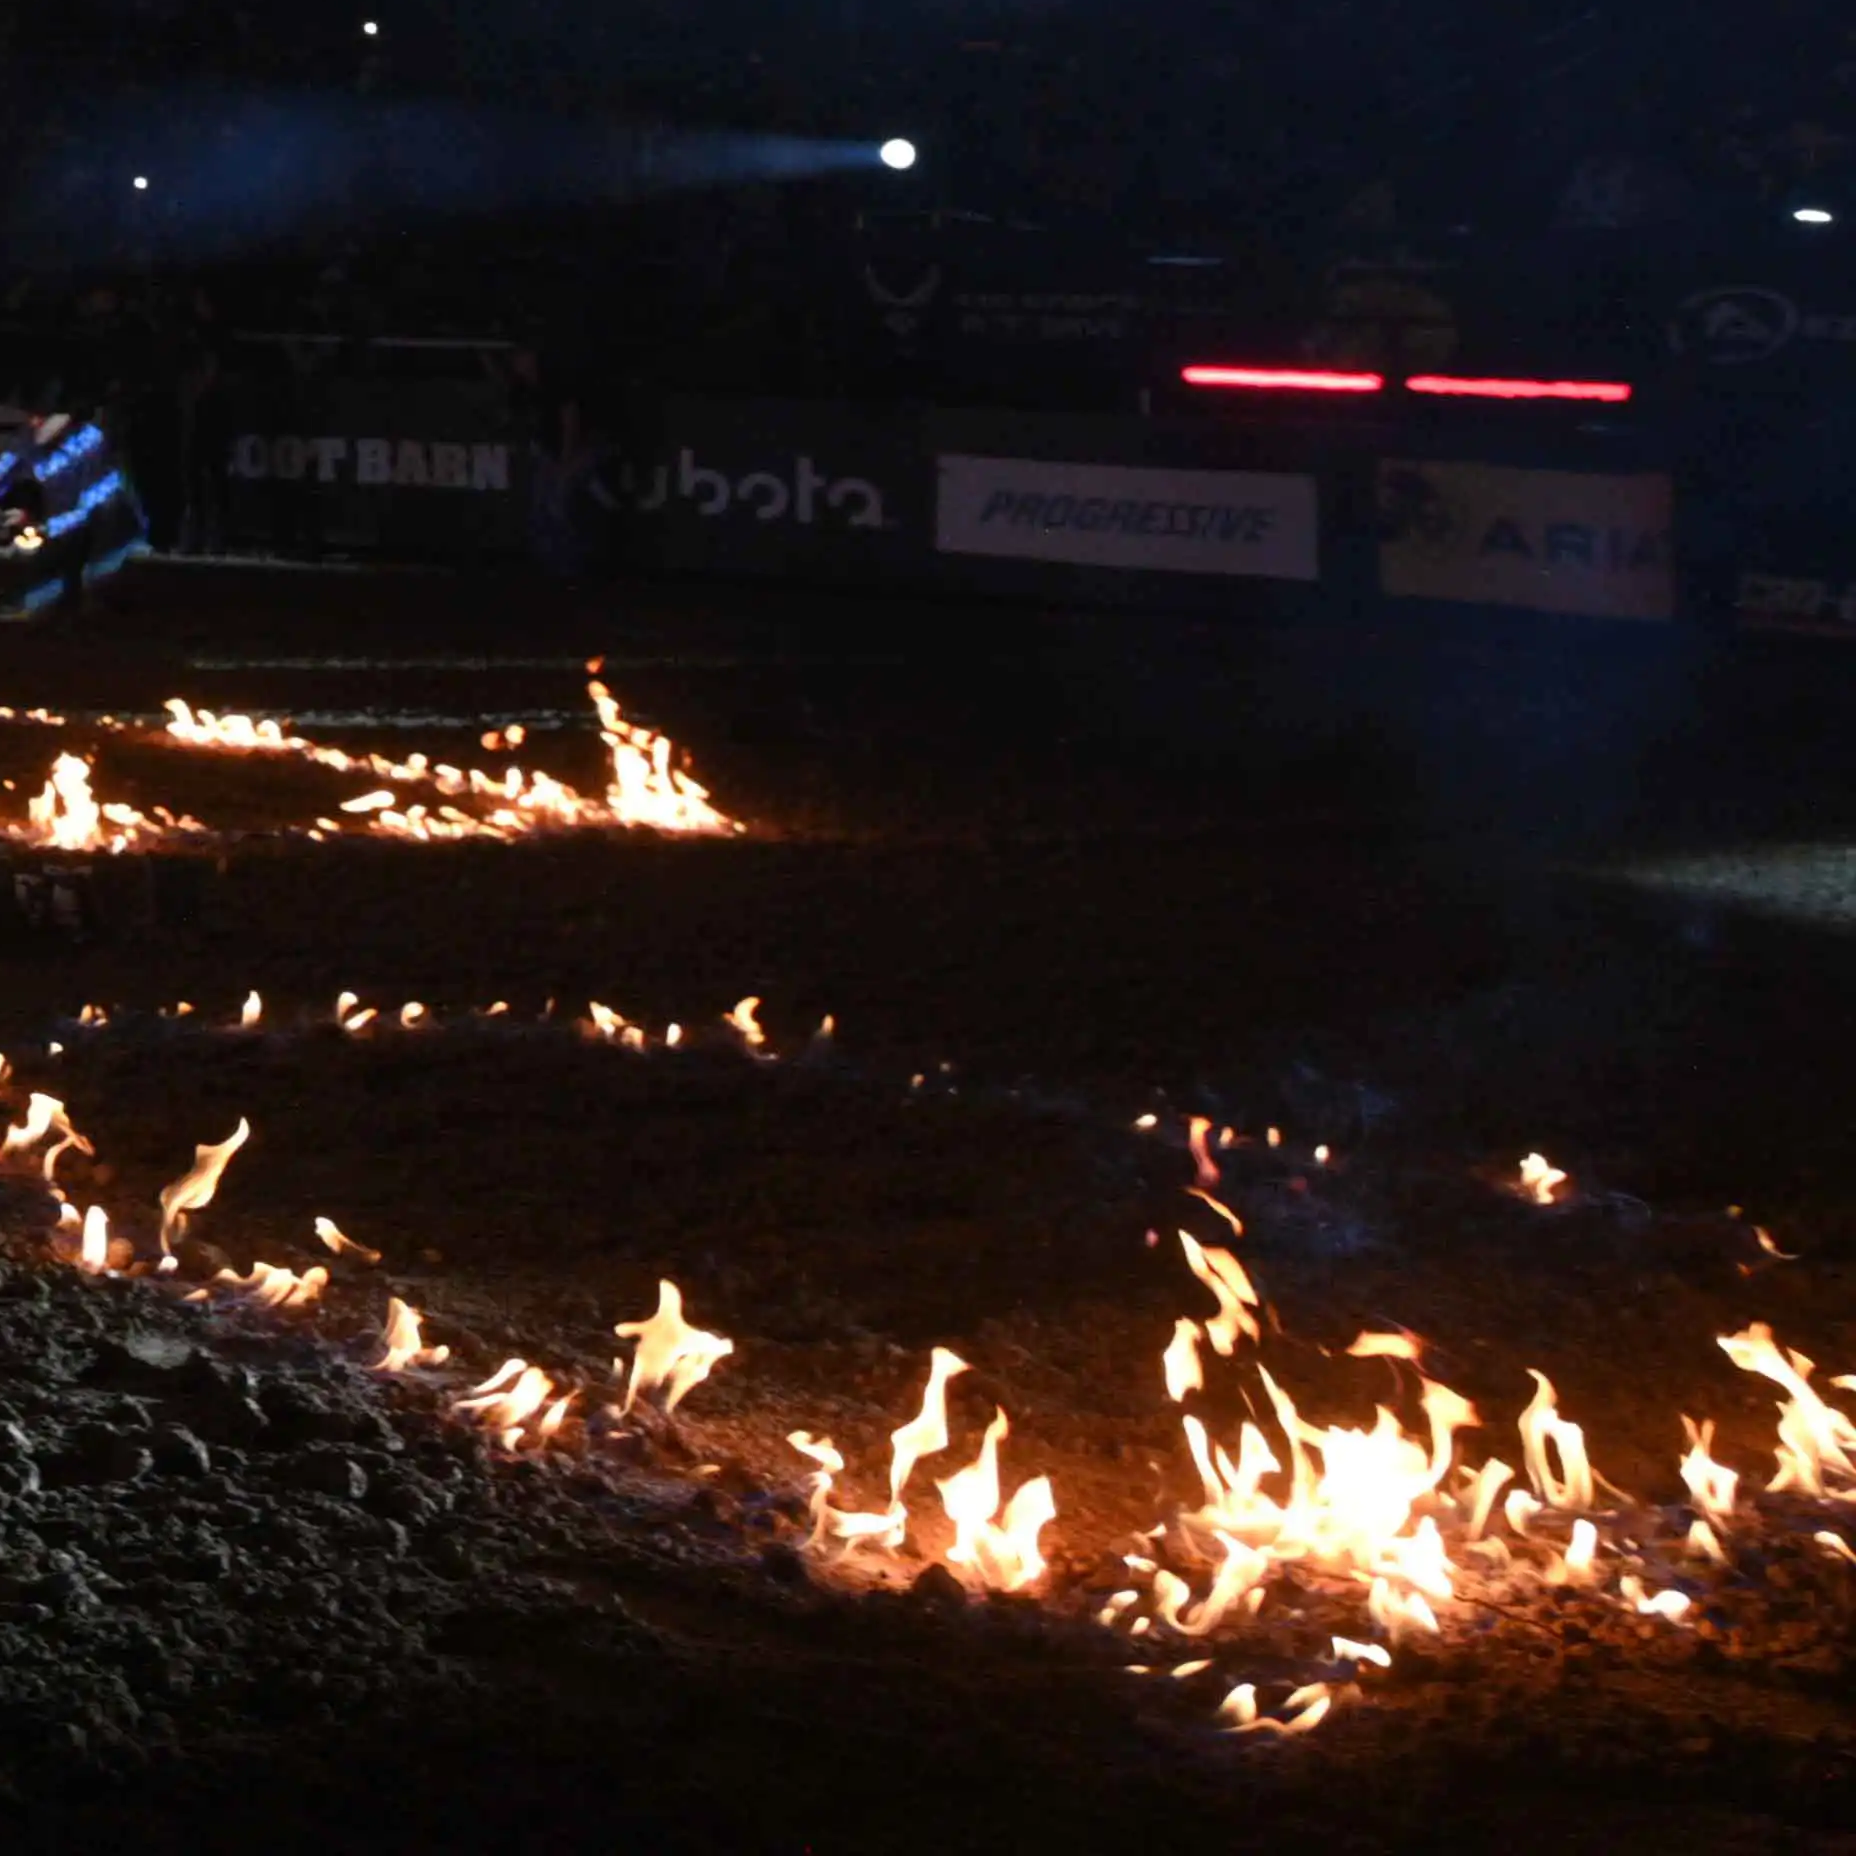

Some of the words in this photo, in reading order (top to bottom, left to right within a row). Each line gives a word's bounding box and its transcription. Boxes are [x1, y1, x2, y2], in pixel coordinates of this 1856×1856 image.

[226, 434, 347, 483] OOT
[356, 438, 511, 490] BARN
[1478, 517, 1672, 572] ARIA
